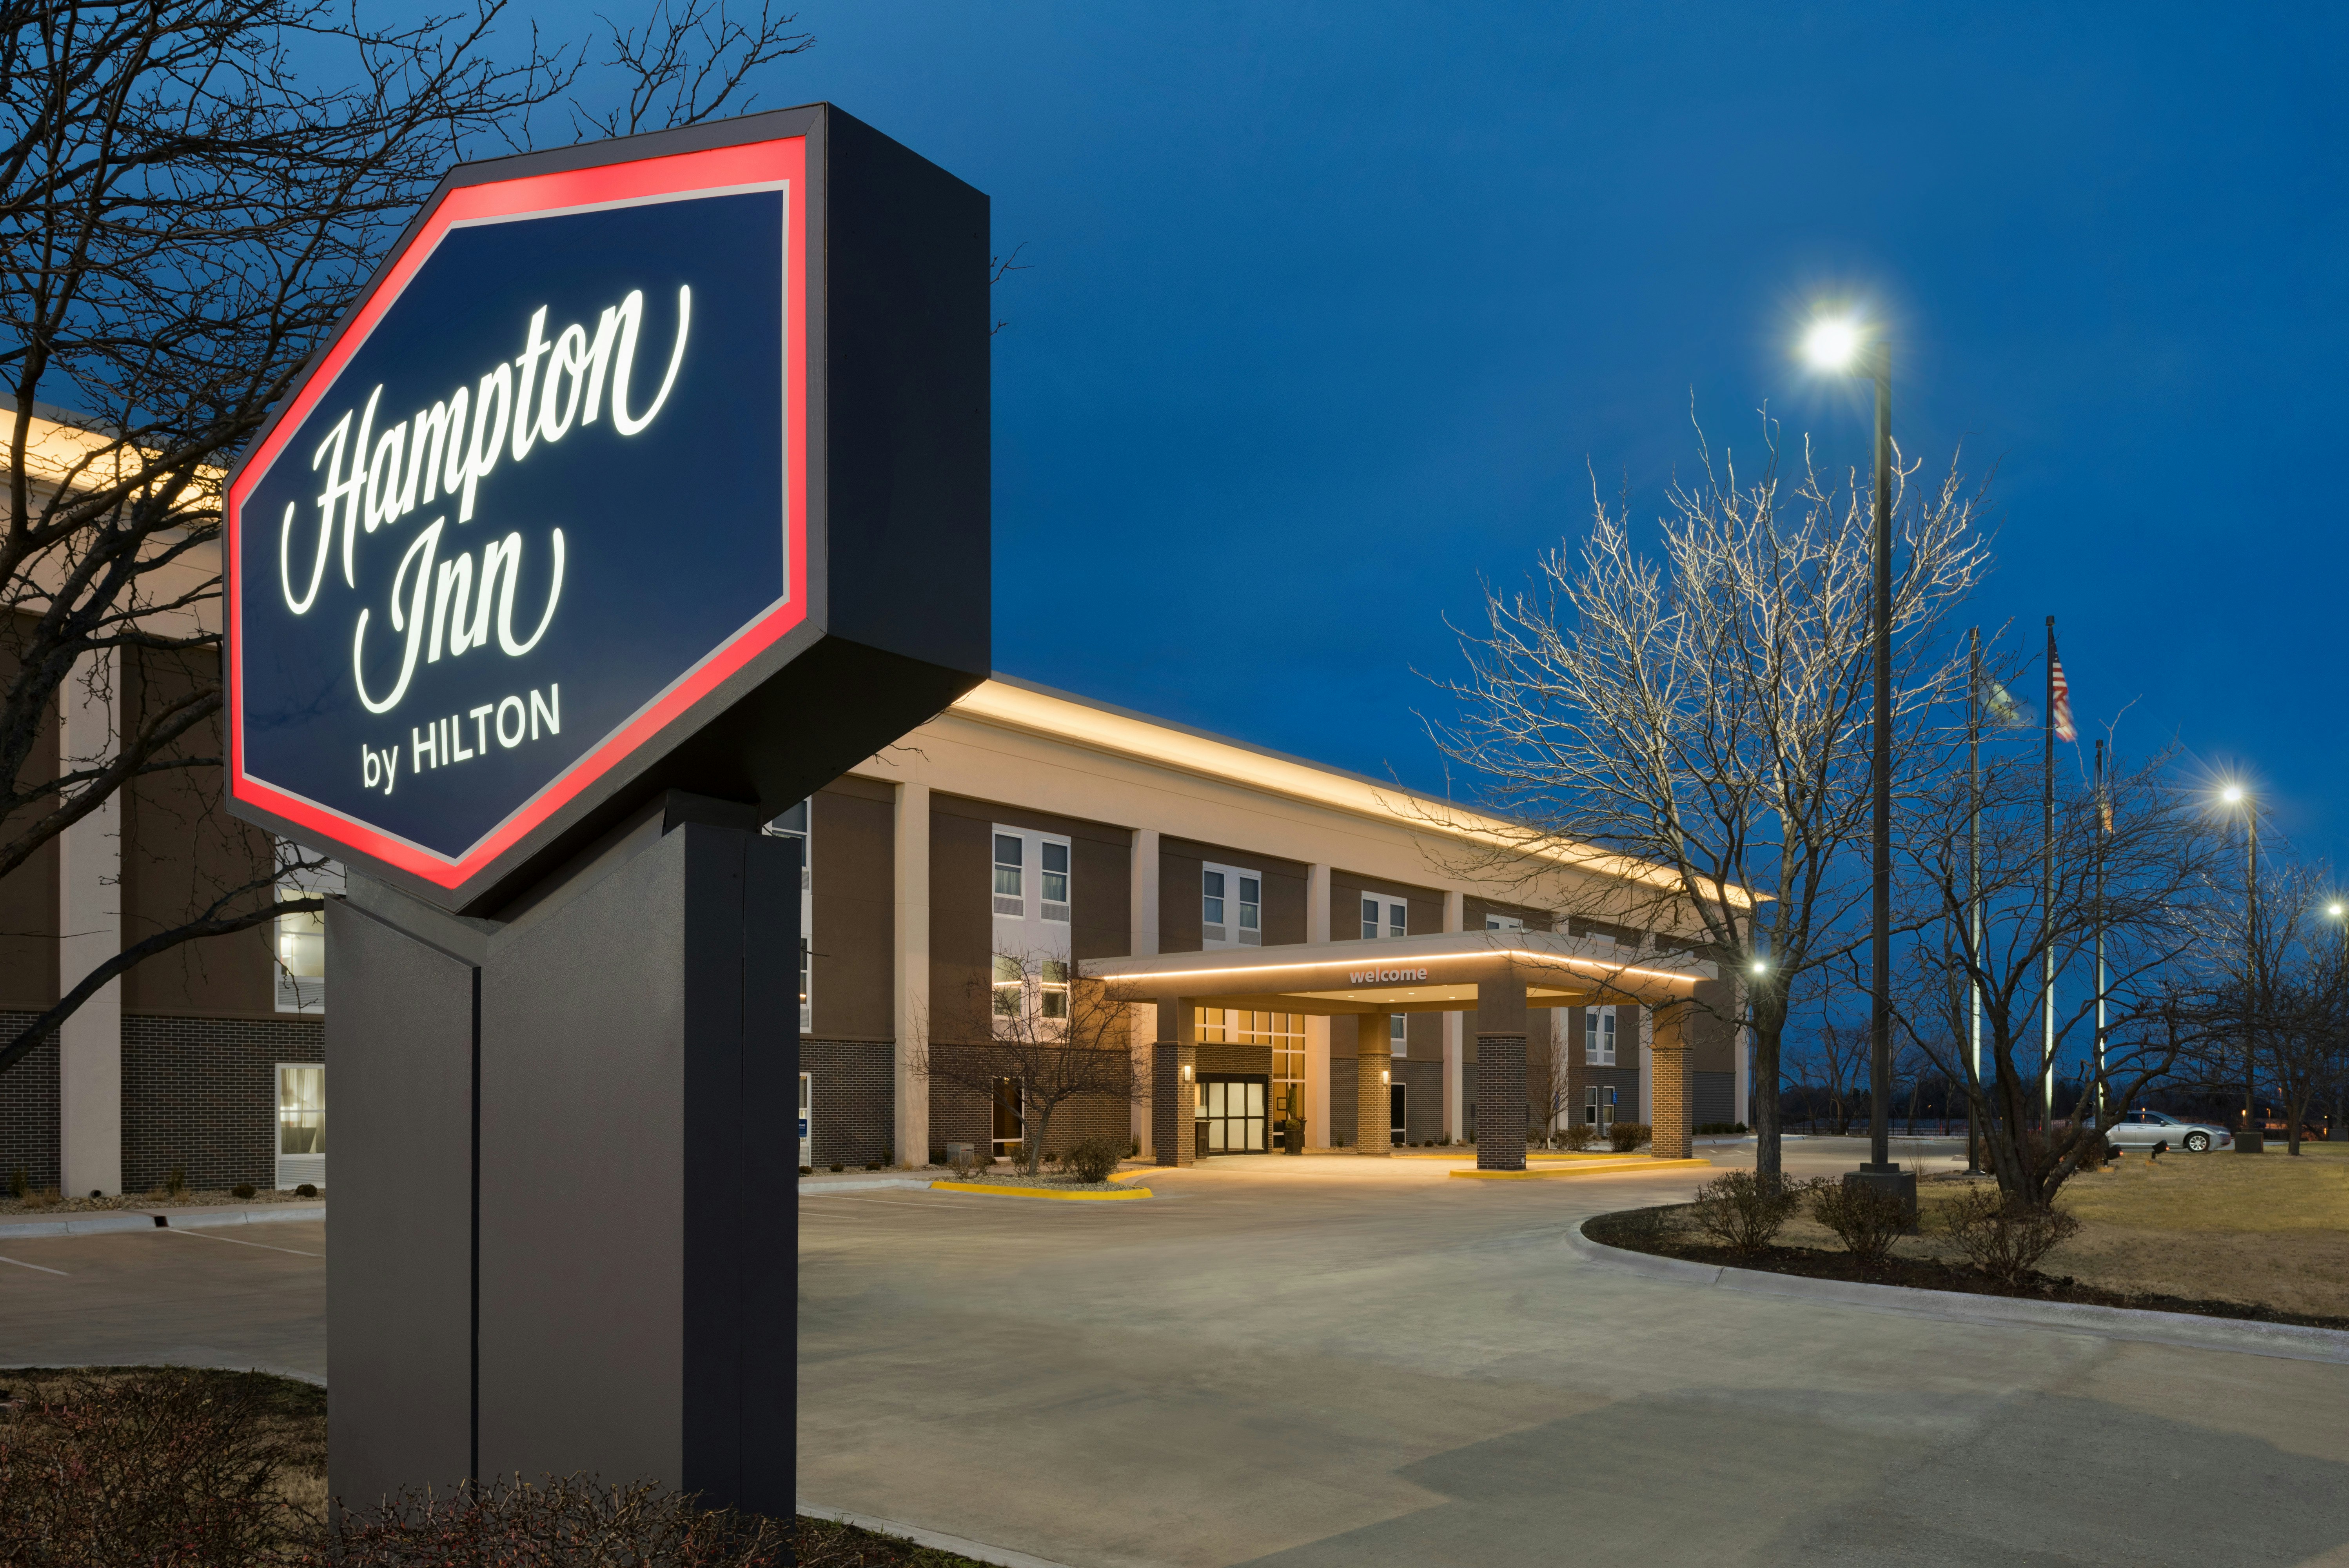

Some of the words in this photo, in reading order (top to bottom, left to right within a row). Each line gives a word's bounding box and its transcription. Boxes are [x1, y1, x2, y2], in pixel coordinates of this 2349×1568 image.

[281, 284, 691, 615] Hampton
[353, 515, 565, 714] Inn
[363, 744, 398, 795] by
[413, 683, 560, 773] HILTON
[1349, 966, 1427, 983] welcome
